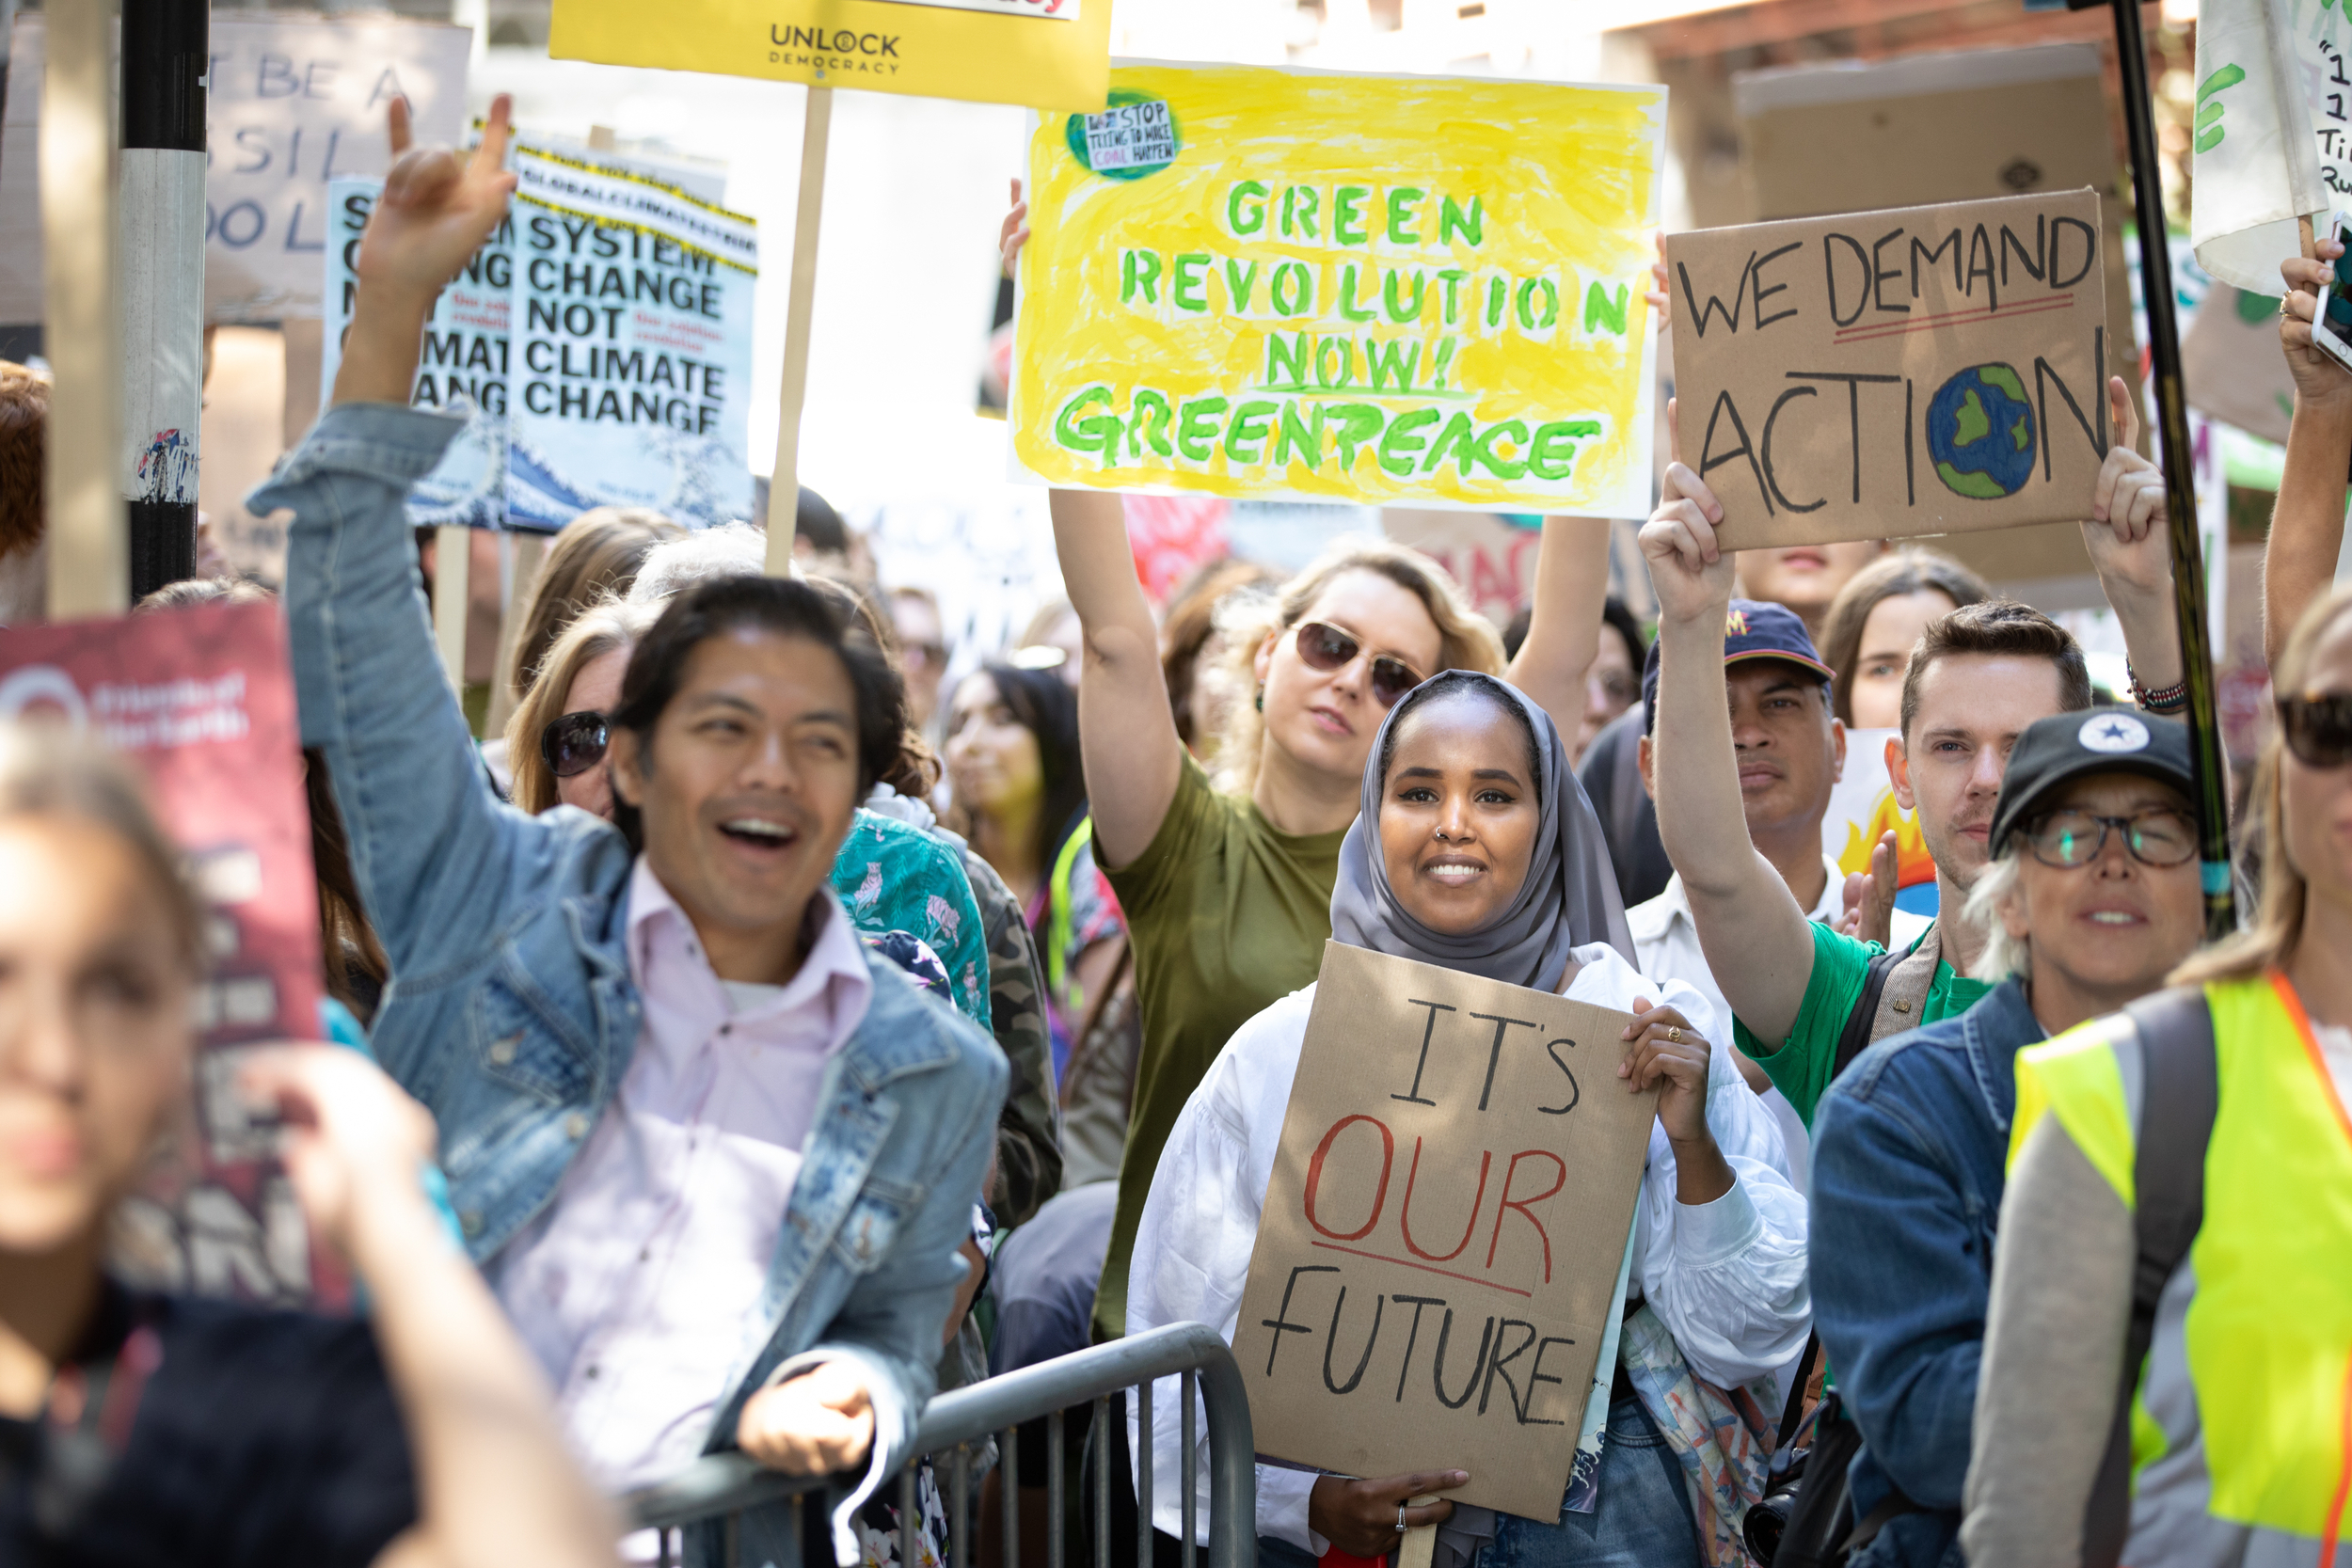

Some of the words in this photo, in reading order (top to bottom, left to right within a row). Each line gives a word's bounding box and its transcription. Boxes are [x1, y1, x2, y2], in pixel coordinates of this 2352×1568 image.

[769, 51, 899, 74] DEMOCRACY
[771, 24, 900, 57] UNLOCK
[256, 54, 341, 99] BE
[365, 66, 413, 118] A
[1120, 103, 1165, 129] STOP
[1094, 149, 1127, 166] COAL
[1133, 143, 1173, 163] HAPPEN
[2317, 128, 2352, 162] Ti
[1228, 181, 1483, 246] GREEN
[529, 257, 722, 320] CHANGE
[1120, 249, 1629, 336] REVOLUTION
[1677, 242, 1804, 338] WE
[1823, 214, 2096, 326] DEMAND
[529, 297, 626, 340] NOT
[525, 340, 725, 402] CLIMATE
[1267, 331, 1456, 391] NOW!
[524, 380, 720, 436] CHANGE
[1056, 385, 1602, 481] GREENPEACE
[1303, 1114, 1566, 1284] OUR
[1261, 1265, 1576, 1426] FUTURE
